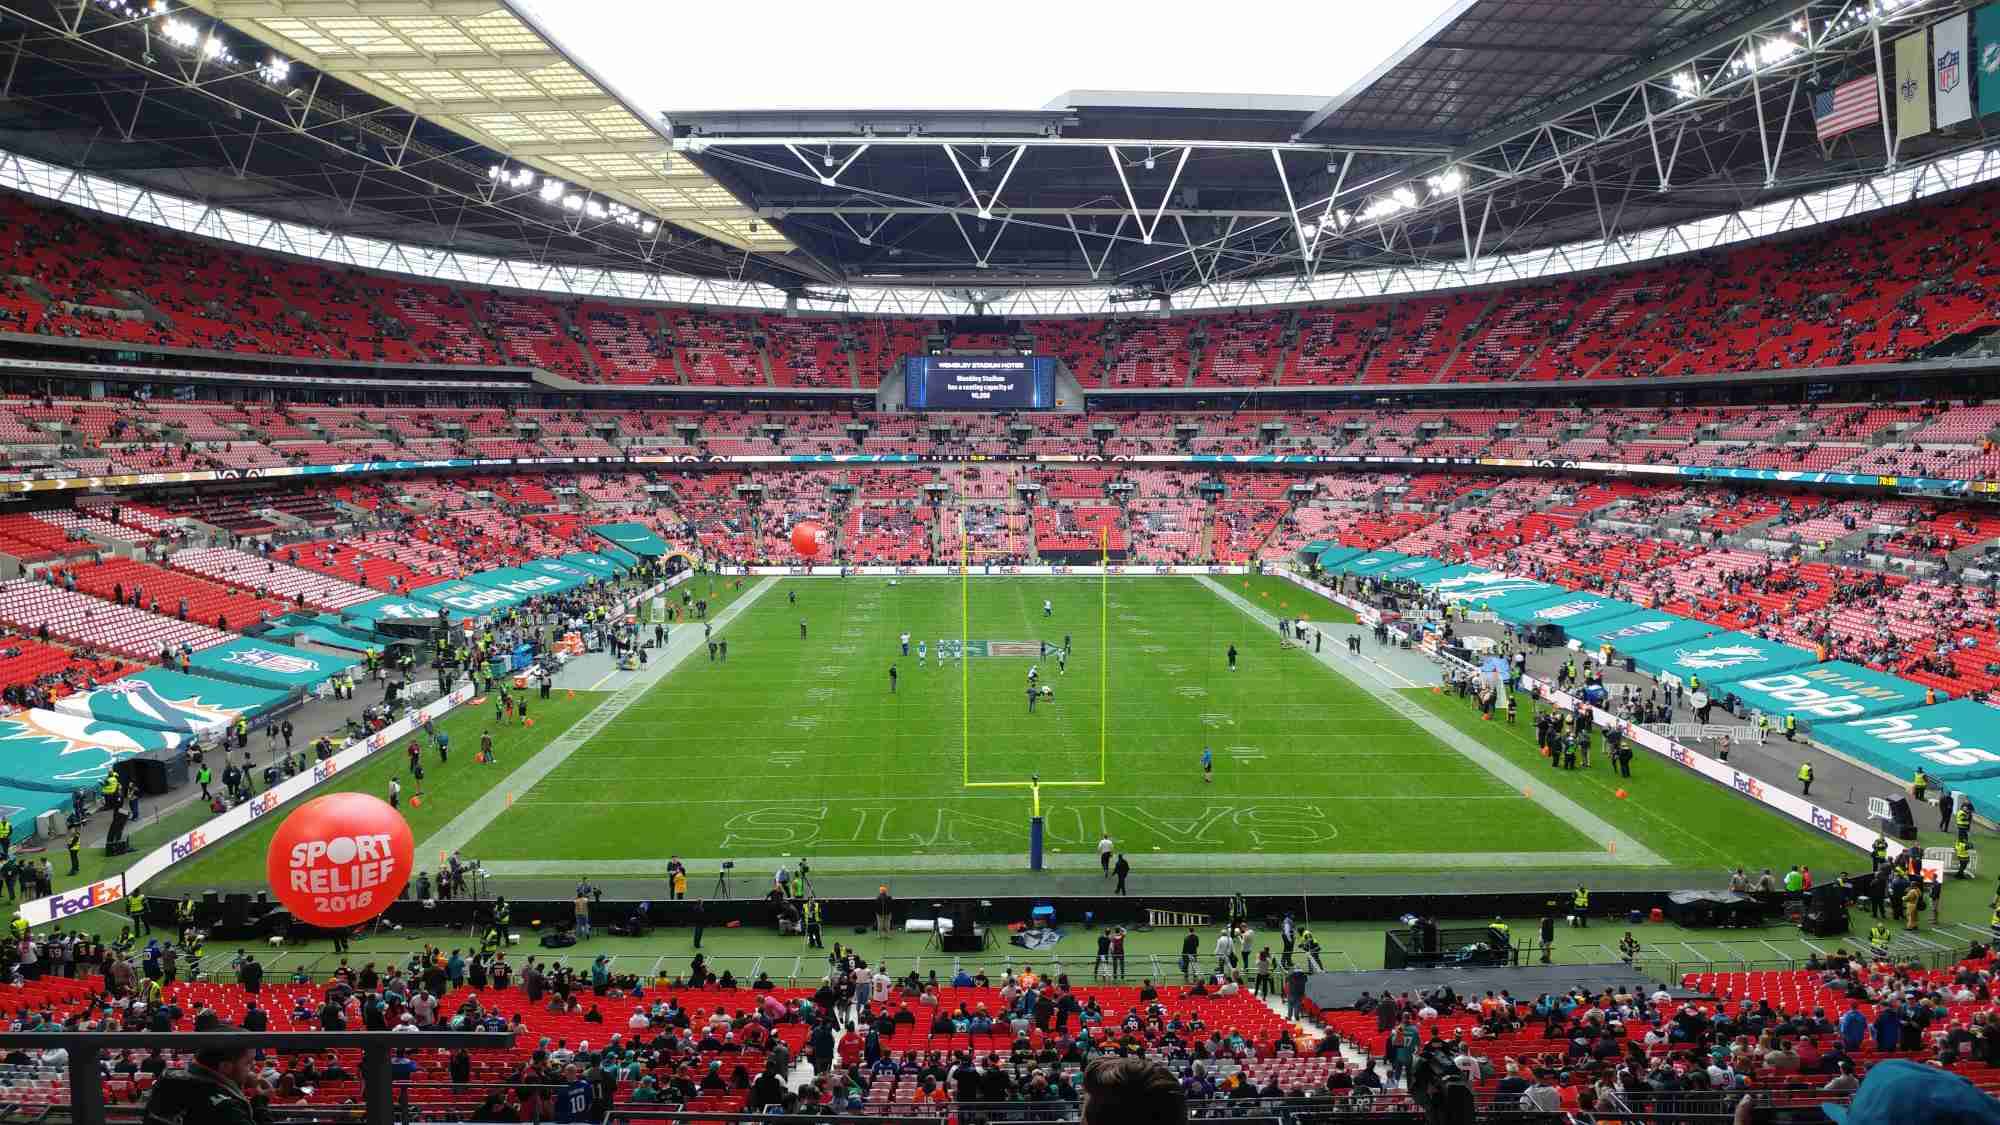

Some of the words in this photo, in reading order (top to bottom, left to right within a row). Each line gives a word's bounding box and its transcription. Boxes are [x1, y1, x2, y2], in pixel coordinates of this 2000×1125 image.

[1804, 669, 1905, 701] MIAMI
[366, 732, 385, 754] FedEx
[1670, 743, 1695, 768] FedEx
[313, 759, 337, 783] FedEx
[1733, 771, 1763, 800] FedEx
[250, 791, 280, 818] FedEx
[1811, 807, 1847, 839] FedEx
[171, 831, 207, 864] FedEx
[289, 834, 391, 868] SPORT
[290, 858, 395, 894] RELIEF
[50, 880, 123, 919] FedEx
[314, 891, 373, 913] 2018
[570, 1096, 585, 1114] 10
